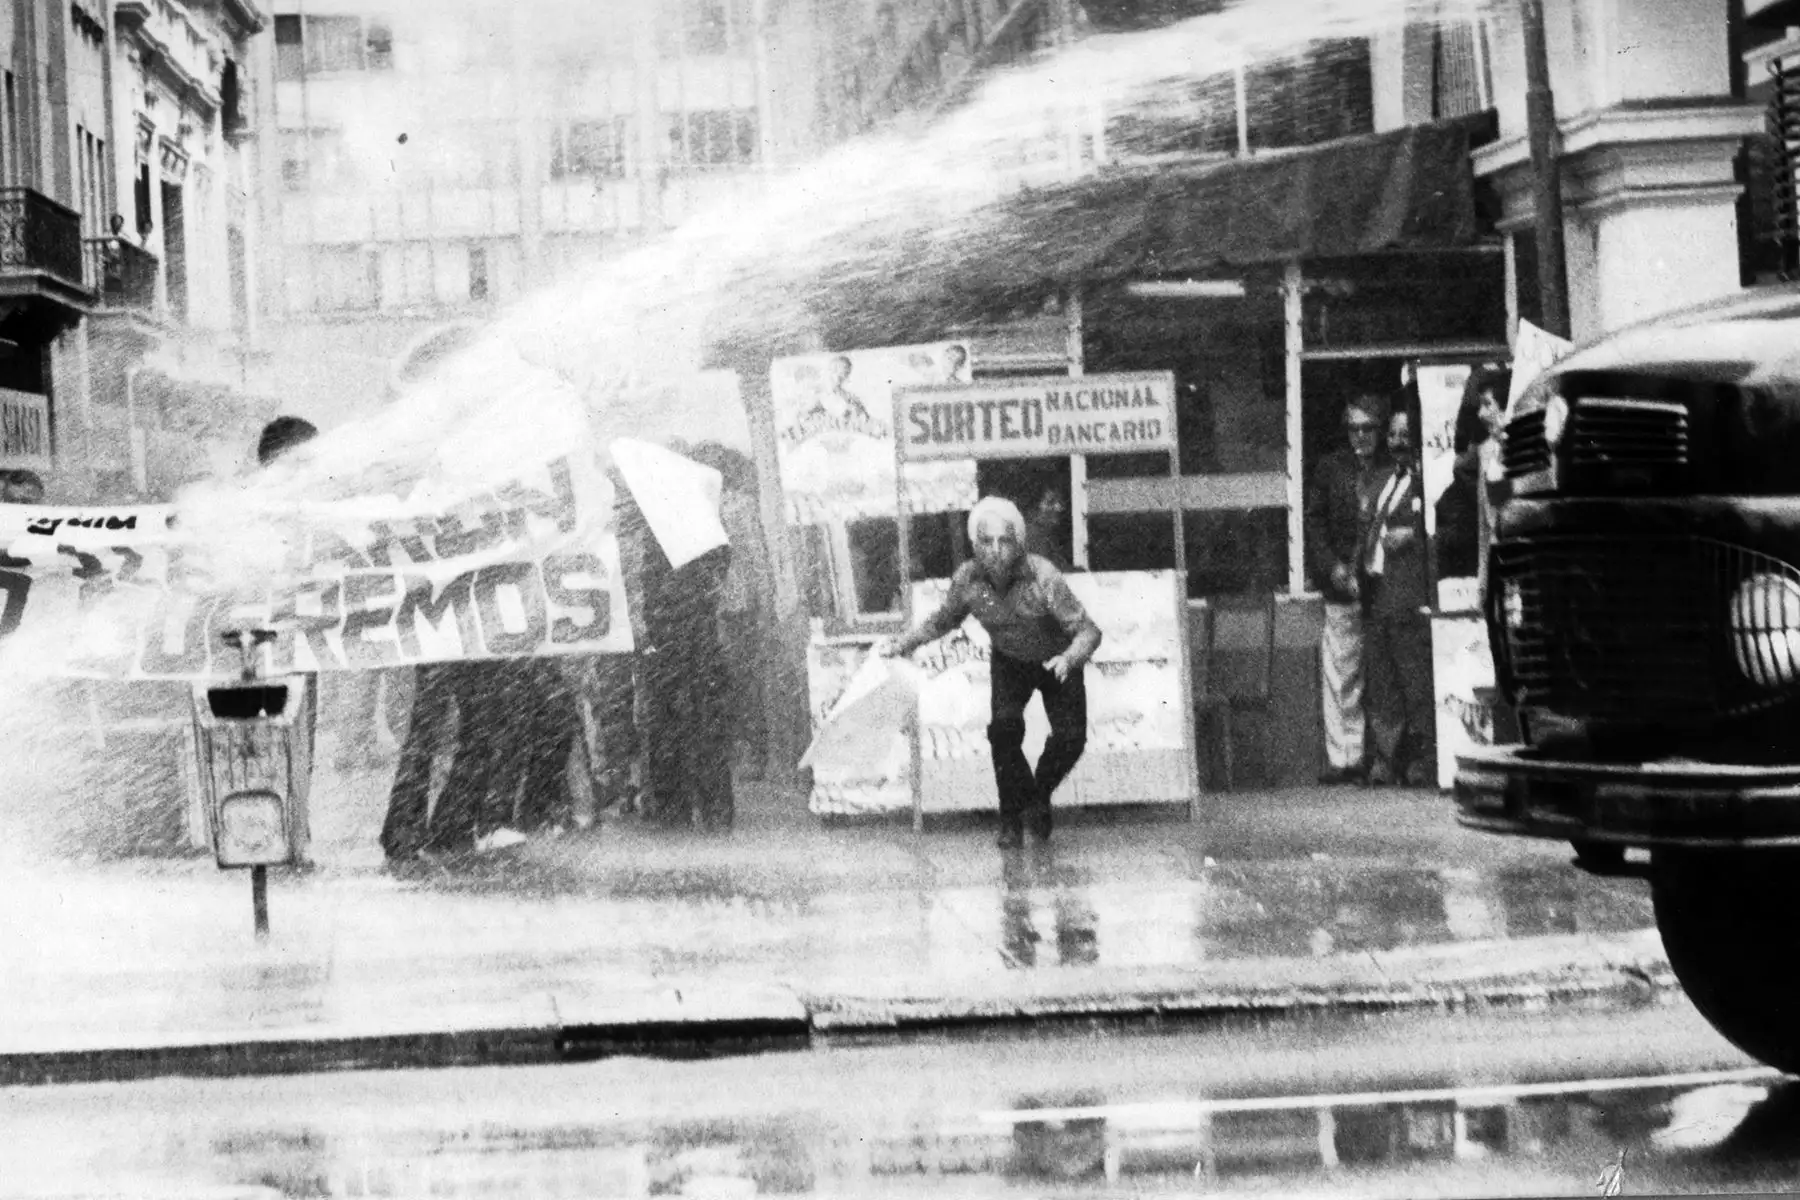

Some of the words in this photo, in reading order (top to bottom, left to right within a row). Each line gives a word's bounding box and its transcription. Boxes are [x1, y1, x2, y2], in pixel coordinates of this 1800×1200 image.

[1046, 386, 1160, 411] NACIONAL
[909, 398, 1043, 444] SORTEO
[1048, 419, 1161, 445] BANCARIO
